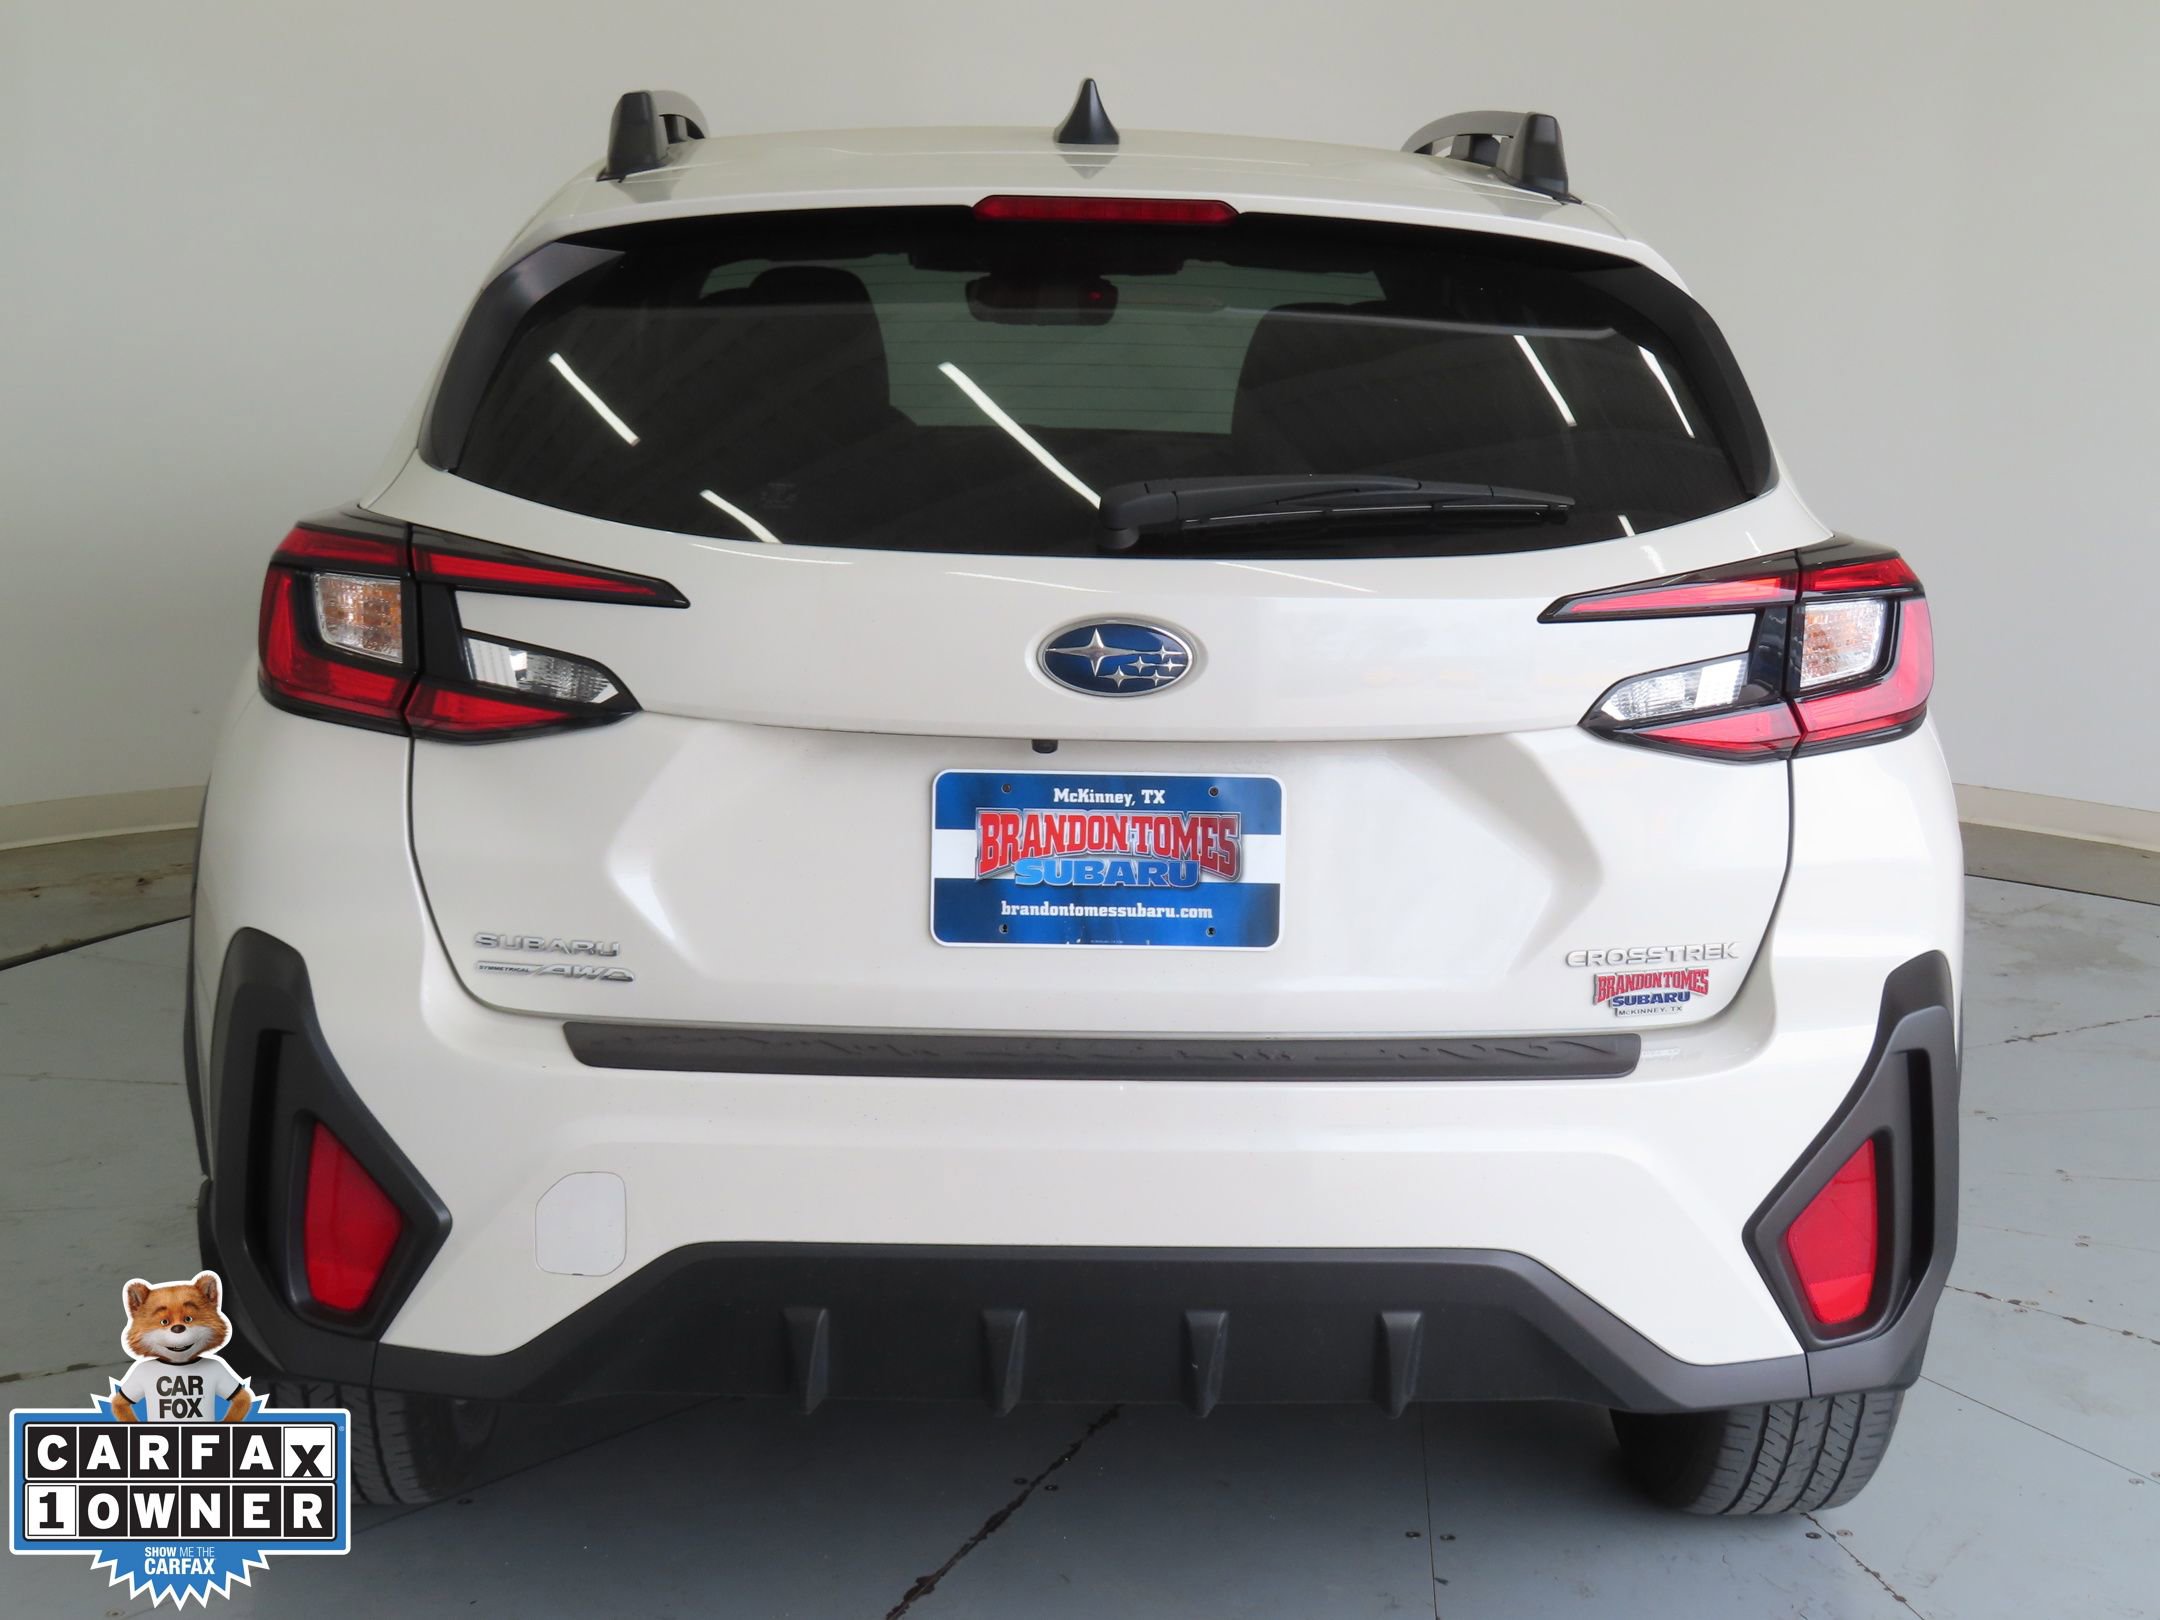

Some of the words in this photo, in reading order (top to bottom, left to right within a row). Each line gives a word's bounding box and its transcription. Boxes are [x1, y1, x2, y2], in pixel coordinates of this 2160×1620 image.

[1053, 787, 1136, 807] McKinney,
[1141, 789, 1166, 805] TX
[1014, 858, 1200, 888] SUBARU
[1001, 901, 1213, 920] brandontomessubaru.com
[474, 932, 621, 958] SUBARU
[1565, 941, 1742, 967] CROSSTREK
[537, 963, 635, 983] AWD
[1612, 990, 1692, 1007] SUBARU
